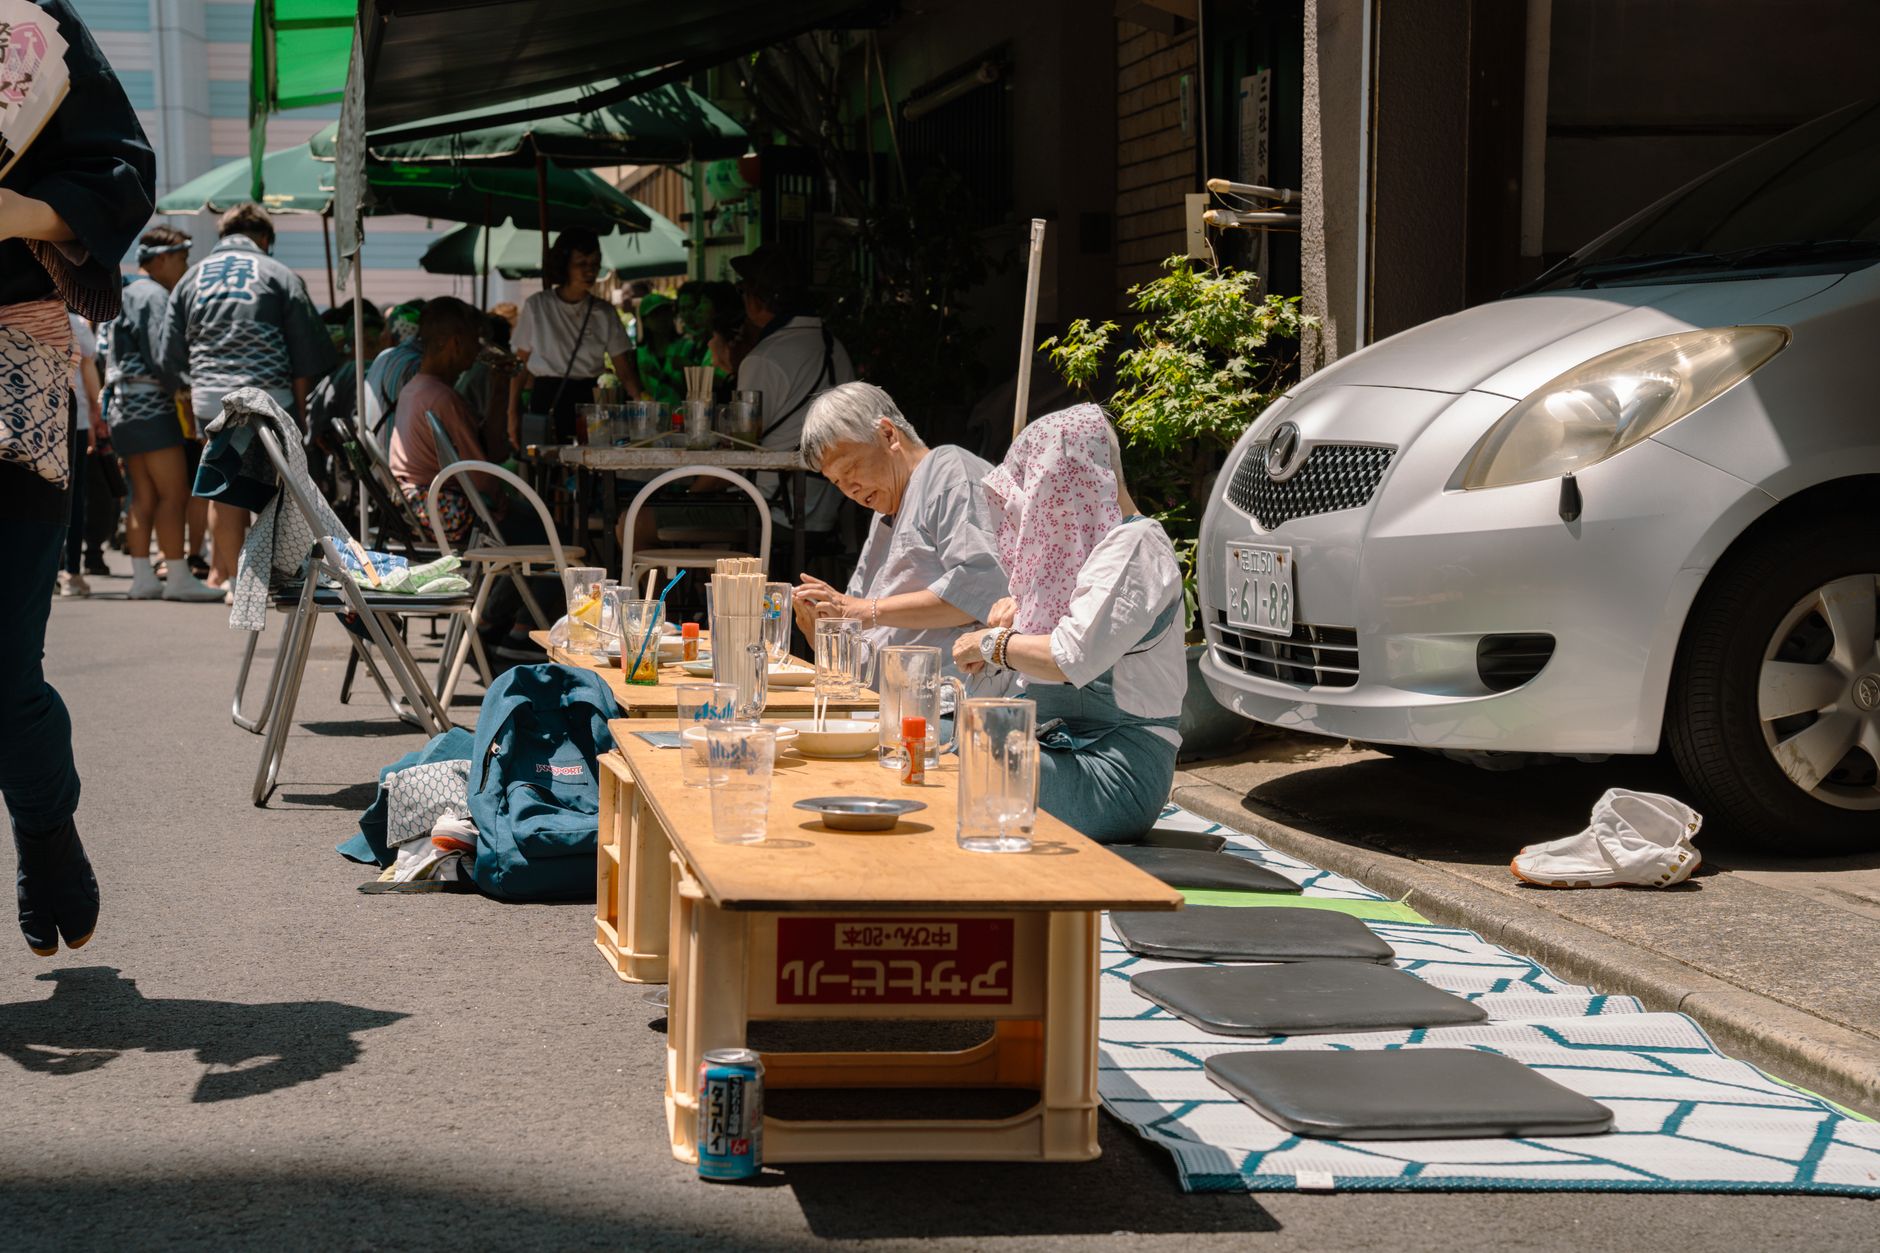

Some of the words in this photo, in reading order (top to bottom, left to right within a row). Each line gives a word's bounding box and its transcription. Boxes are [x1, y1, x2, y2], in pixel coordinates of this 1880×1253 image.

[1241, 548, 1259, 573] 足立
[1241, 578, 1289, 627] 61-88
[535, 763, 583, 776] JANSPORT
[781, 959, 1009, 996] アサヒビール
[711, 1086, 723, 1151] タコハイ
